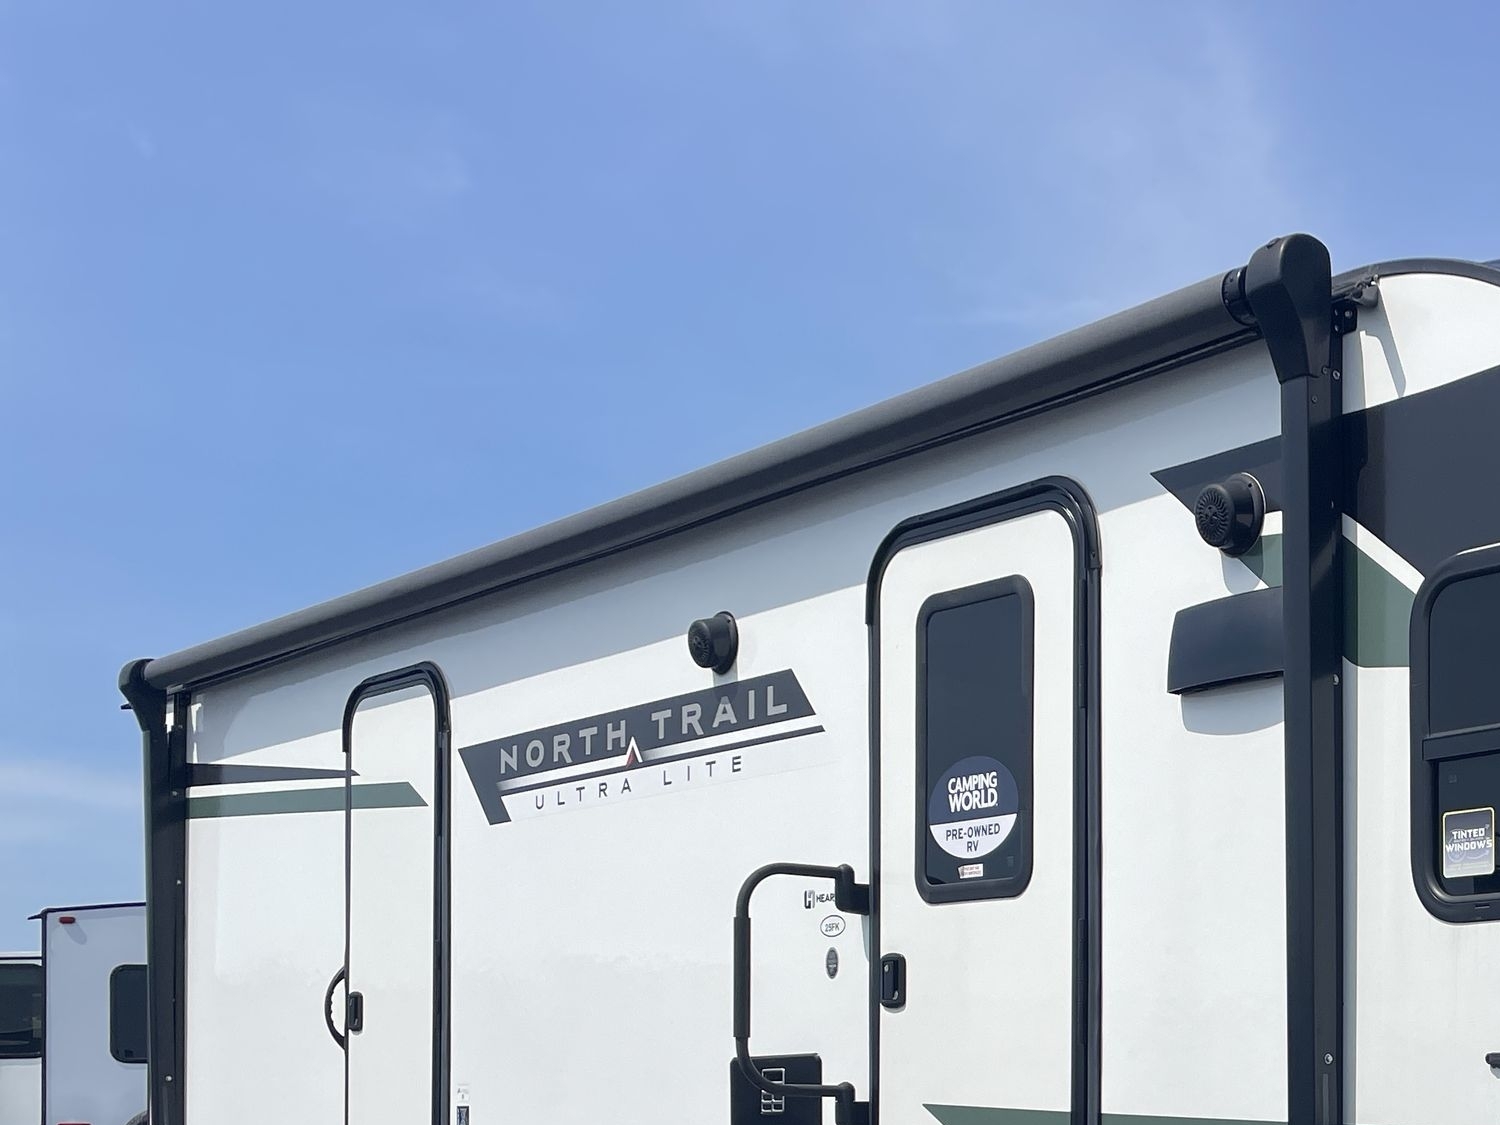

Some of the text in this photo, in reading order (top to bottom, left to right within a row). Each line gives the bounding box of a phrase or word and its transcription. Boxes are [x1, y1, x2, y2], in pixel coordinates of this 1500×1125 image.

[500, 685, 788, 774] NORTH TRAIL
[535, 755, 743, 809] ULTRA LITE
[947, 771, 998, 794] CAMPING
[948, 788, 998, 813] WORLD
[945, 823, 1001, 841] PRE-OWNED
[1452, 827, 1485, 840] TINTED
[966, 840, 979, 852] RV
[1445, 839, 1493, 853] WINDOWS
[824, 922, 840, 933] 25FK
